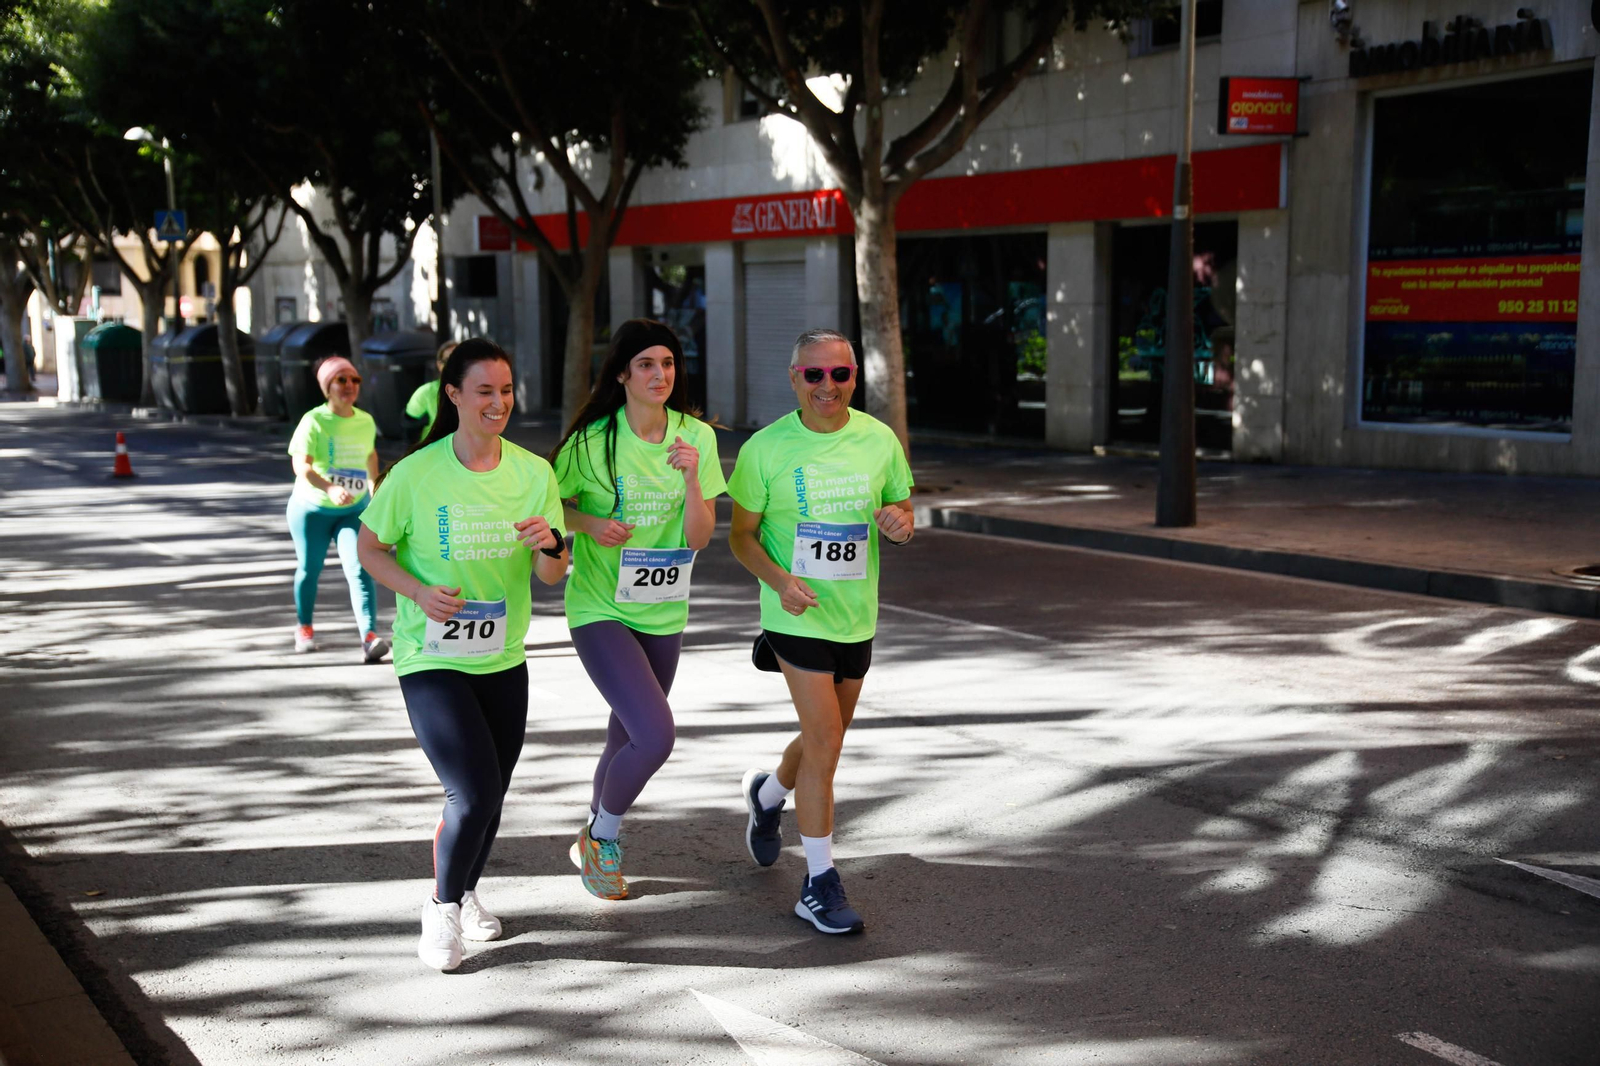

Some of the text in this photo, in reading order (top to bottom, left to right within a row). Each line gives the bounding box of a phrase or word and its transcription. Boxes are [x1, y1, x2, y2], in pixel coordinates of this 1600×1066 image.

[755, 196, 836, 232] GENERALI
[1382, 266, 1427, 279] ayudamos
[1436, 264, 1468, 275] vender
[1478, 262, 1514, 276] alquilar
[1515, 263, 1527, 274] tu
[1428, 278, 1456, 291] mejor
[1499, 276, 1543, 290] personal
[1498, 299, 1577, 314] 950 25 11 12
[330, 475, 364, 490] 1510
[808, 472, 870, 489] En marcha
[626, 489, 641, 500] En
[792, 466, 809, 517] ALMERÍA
[810, 482, 871, 500] contra el
[626, 500, 671, 512] contra
[811, 499, 871, 516] cáncer
[435, 505, 451, 561] ALMERÍA
[452, 519, 469, 531] En
[453, 530, 517, 544] contra el
[453, 545, 517, 561] cáncer
[810, 540, 857, 562] 188
[633, 566, 680, 587] 209
[442, 619, 496, 640] 210
